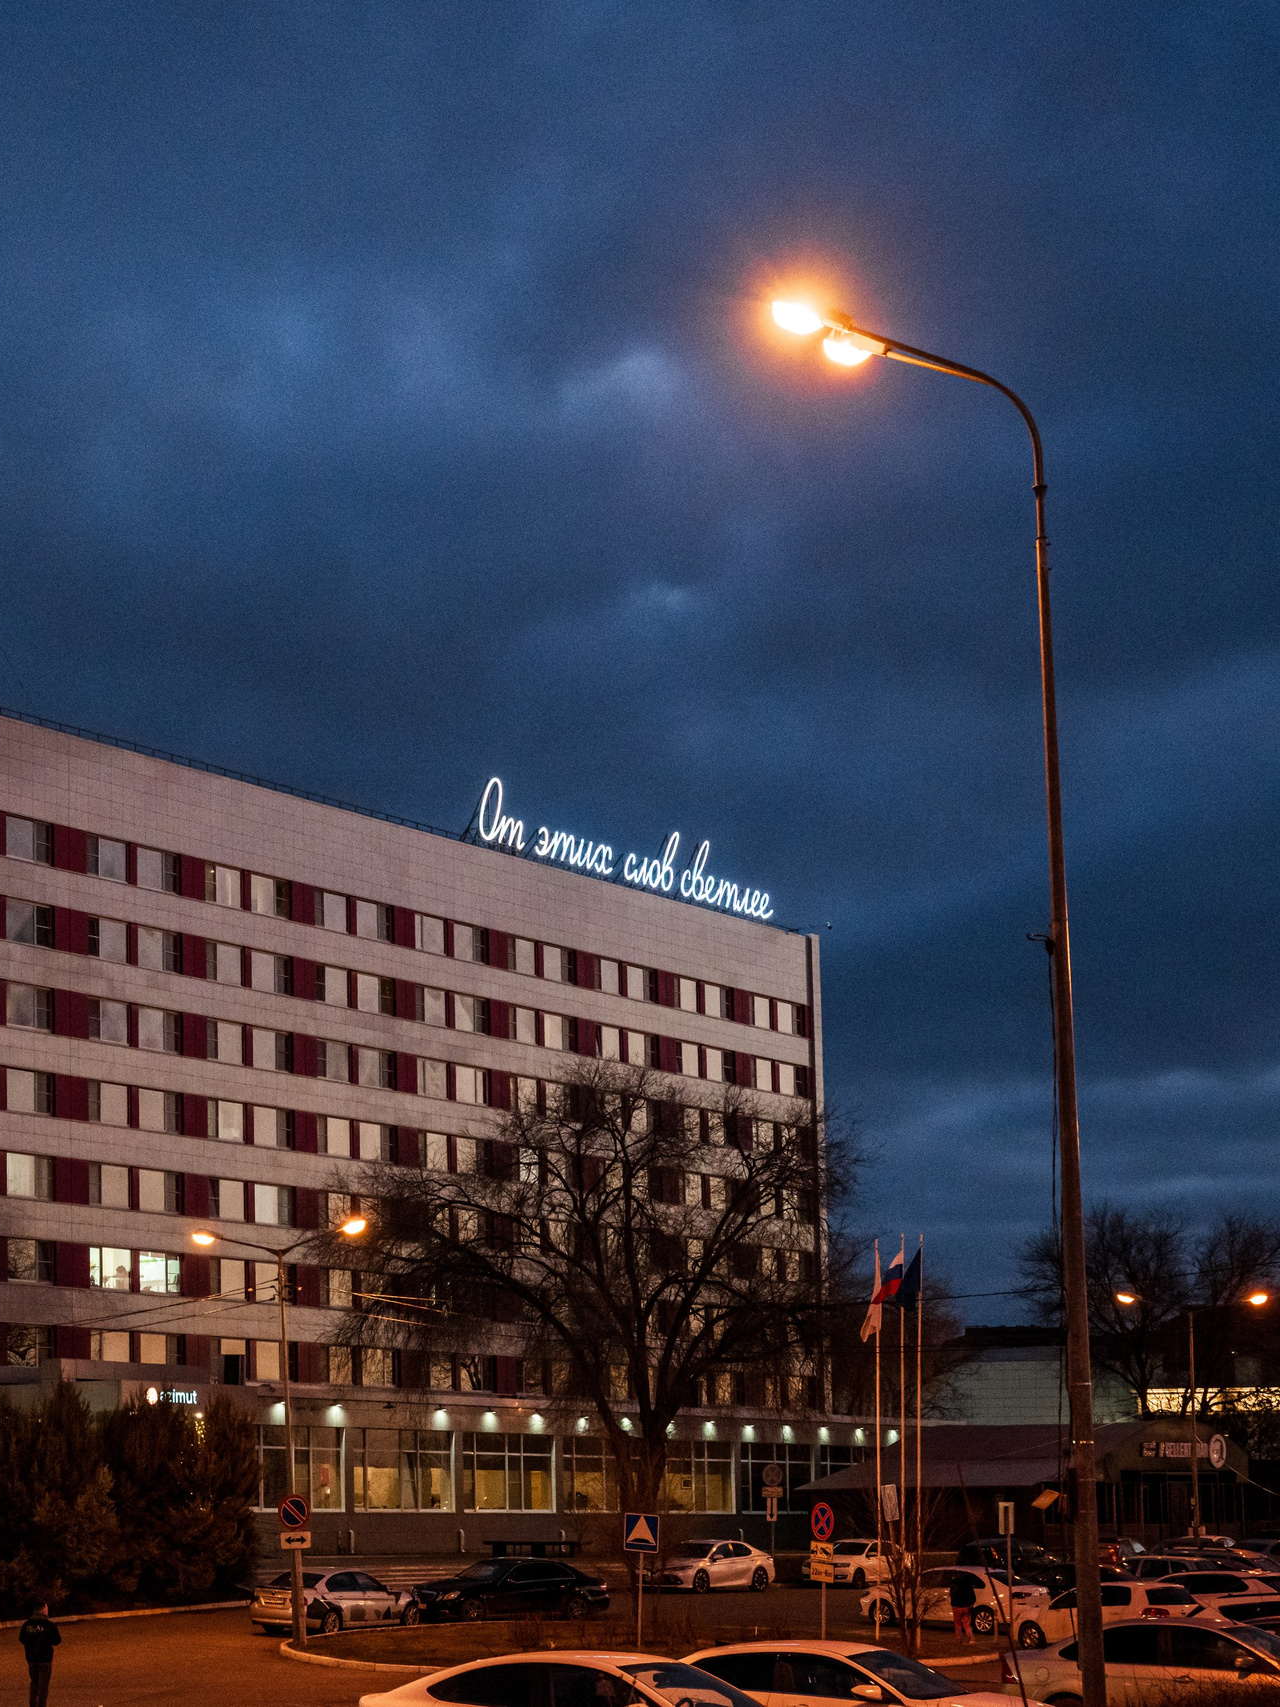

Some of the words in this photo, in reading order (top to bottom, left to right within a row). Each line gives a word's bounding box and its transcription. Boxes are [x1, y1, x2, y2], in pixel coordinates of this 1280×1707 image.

[478, 777, 525, 850] От
[534, 826, 613, 875] этих
[624, 831, 679, 892] слов
[680, 840, 774, 919] светлее
